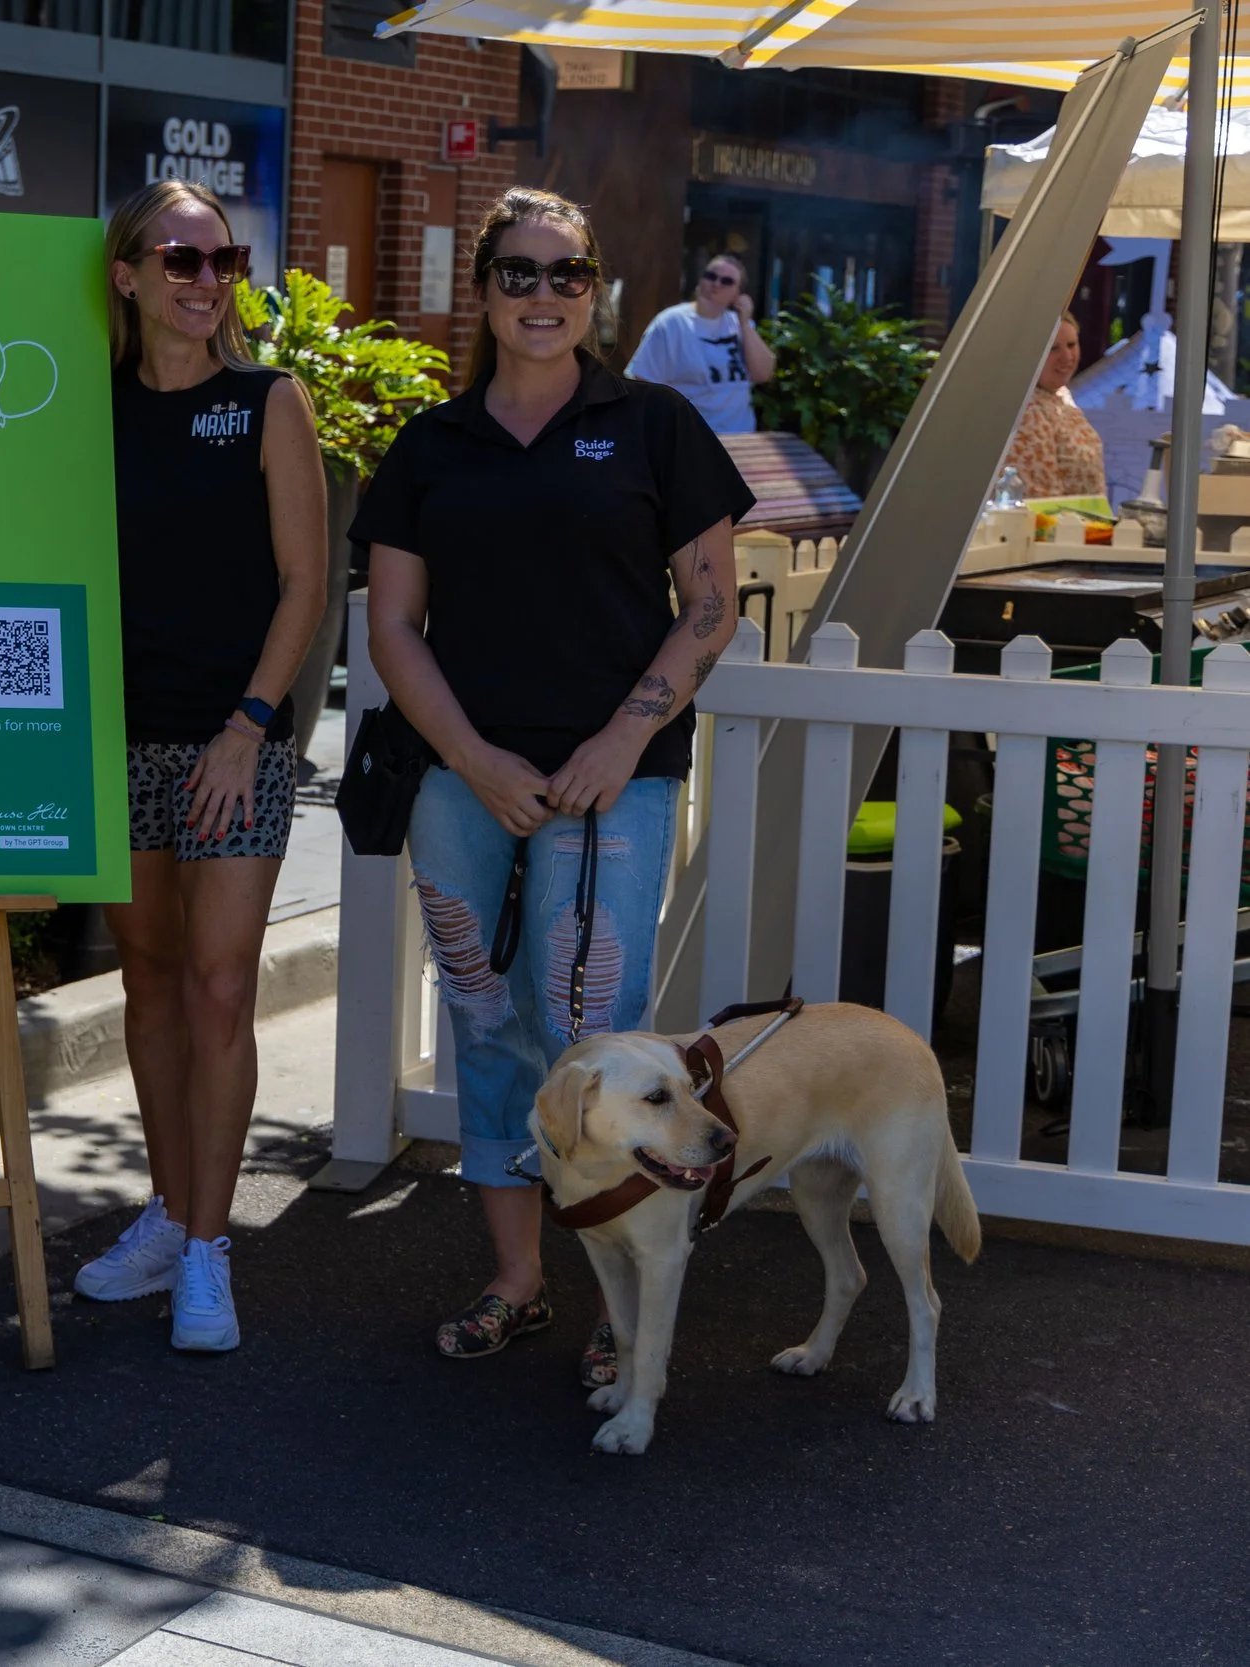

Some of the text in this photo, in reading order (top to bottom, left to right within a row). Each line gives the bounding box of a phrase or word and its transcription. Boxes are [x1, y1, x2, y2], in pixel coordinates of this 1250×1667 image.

[163, 117, 231, 158] GOLD
[146, 153, 245, 196] LOUNGE
[191, 410, 251, 437] MAXFIT
[574, 439, 615, 449] Guide
[5, 719, 24, 731] for
[26, 722, 62, 732] more
[27, 802, 68, 821] Hill
[4, 839, 13, 847] by
[44, 839, 64, 847] Group
